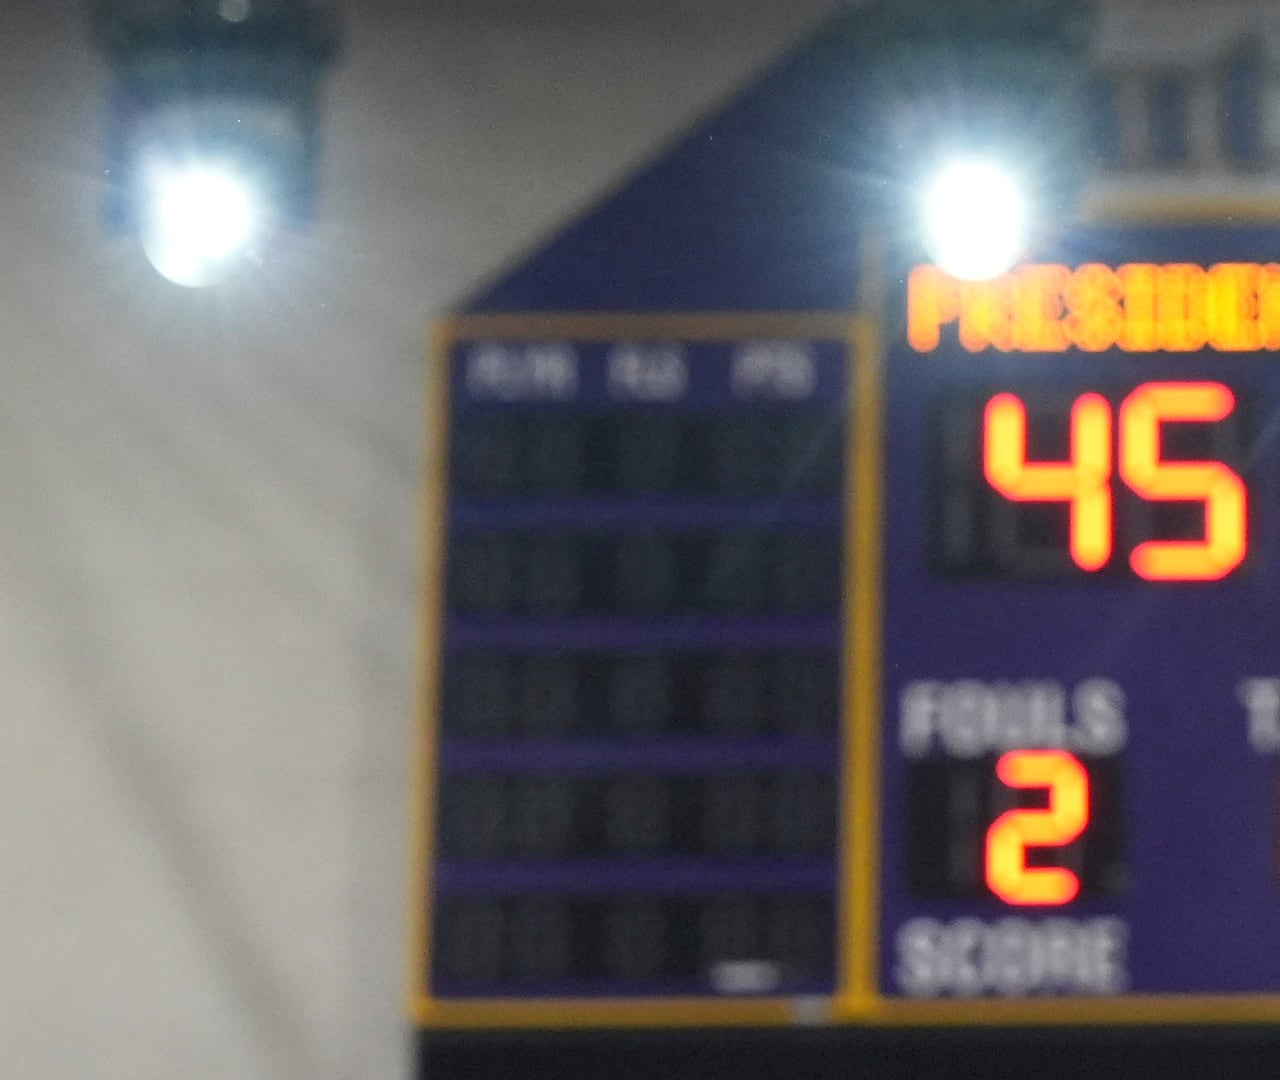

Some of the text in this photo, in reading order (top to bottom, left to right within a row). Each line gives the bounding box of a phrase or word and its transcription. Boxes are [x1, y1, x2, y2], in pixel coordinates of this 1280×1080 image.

[983, 381, 1248, 581] 45
[902, 680, 1126, 756] FOULS
[985, 749, 1091, 906] 2
[897, 917, 1128, 992] SCORE
